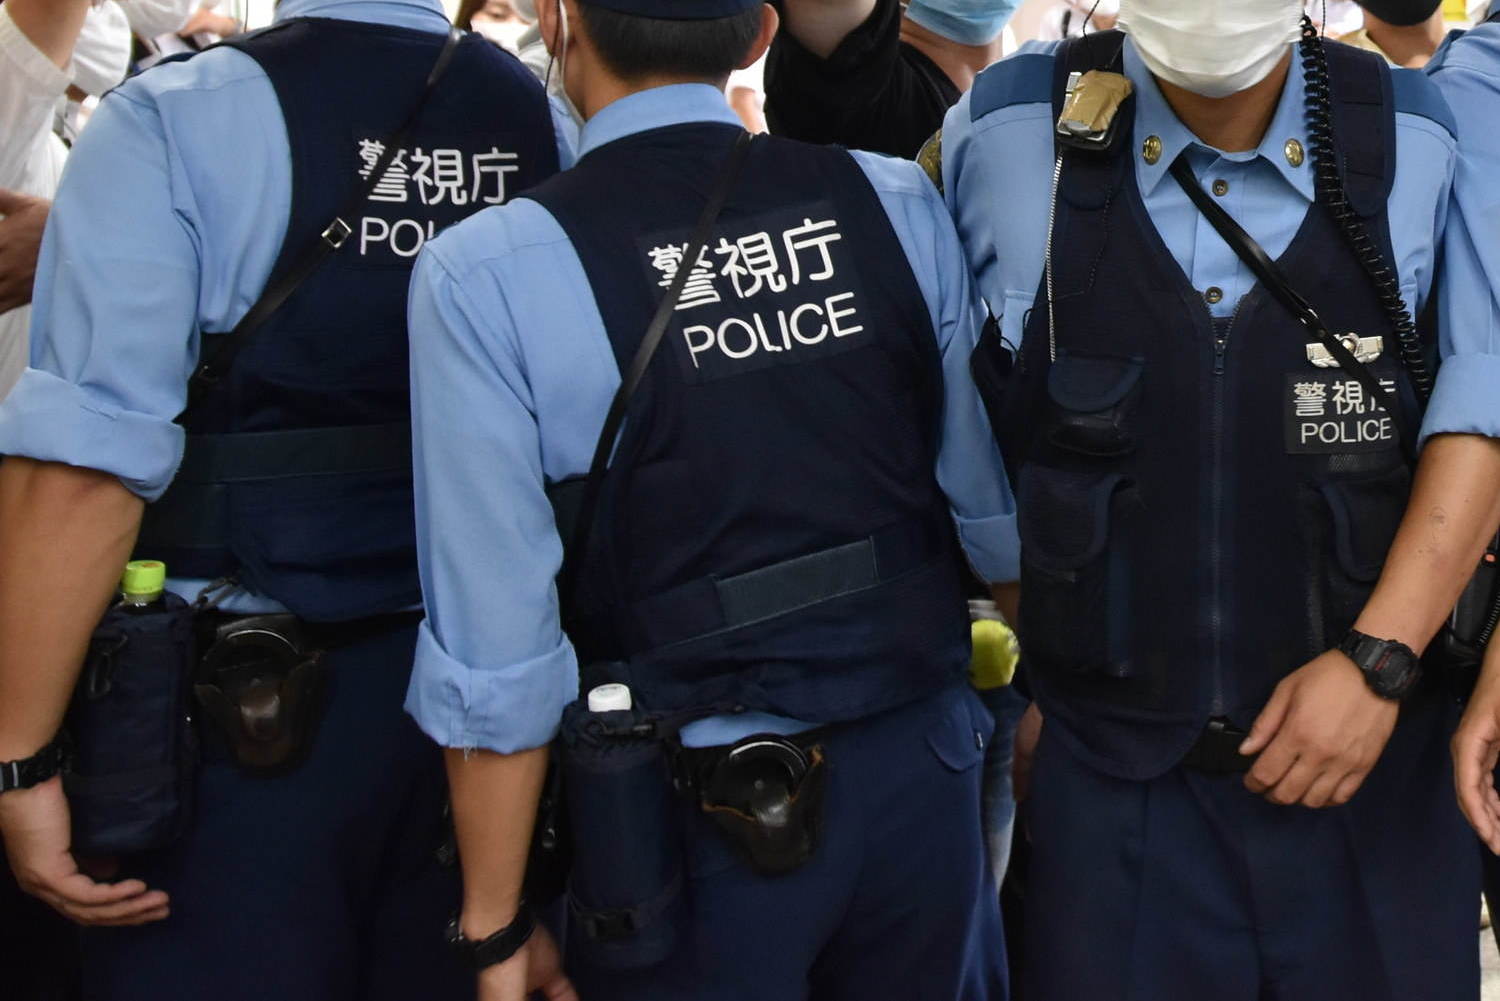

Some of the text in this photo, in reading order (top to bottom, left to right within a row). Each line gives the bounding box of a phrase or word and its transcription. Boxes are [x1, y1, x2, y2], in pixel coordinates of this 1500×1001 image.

[358, 138, 519, 205] 警視庁
[648, 217, 842, 311] 警視庁
[683, 291, 864, 369] POLICE
[1301, 417, 1393, 444] POLICE
